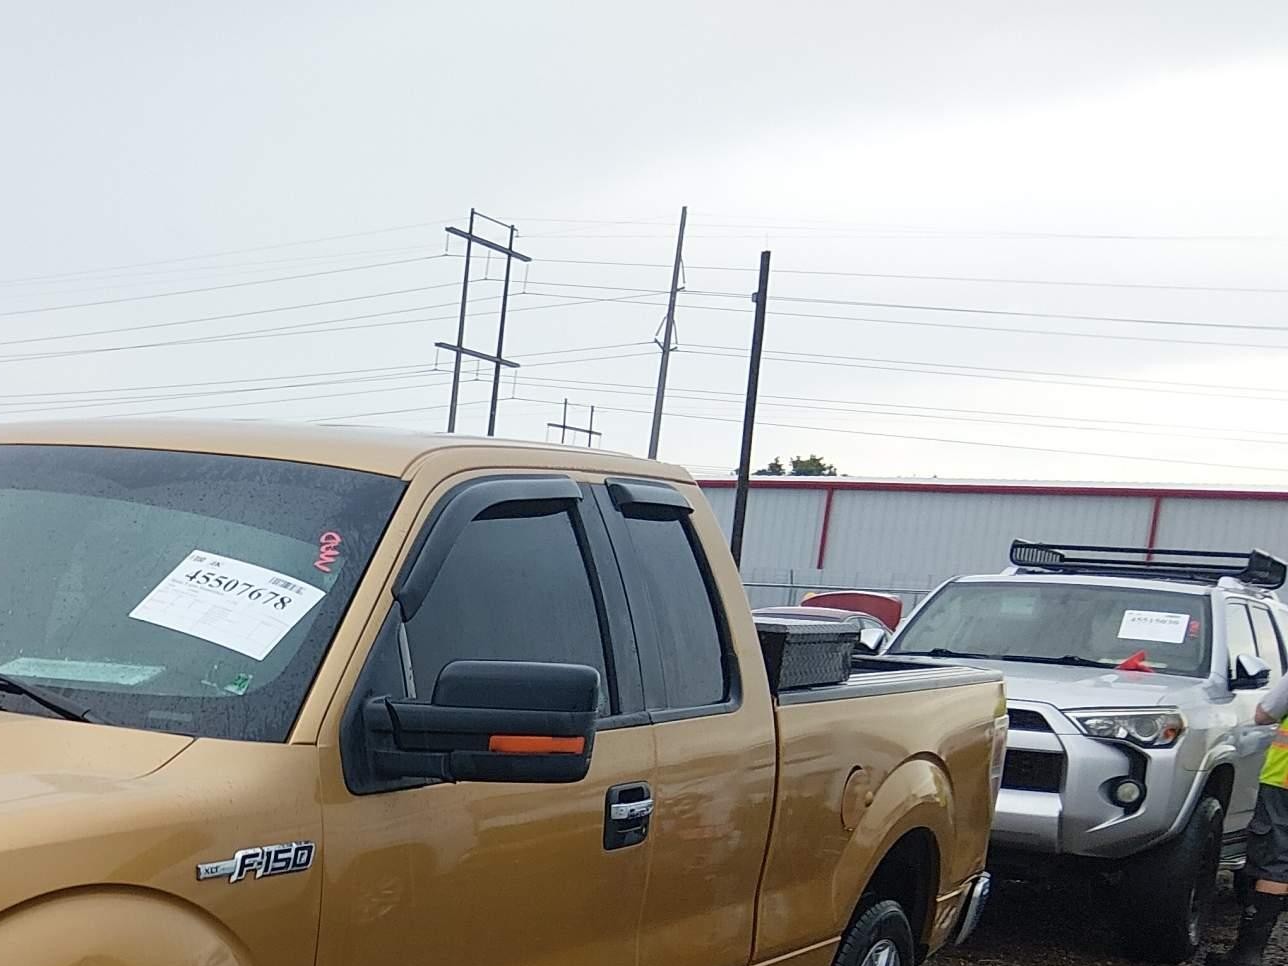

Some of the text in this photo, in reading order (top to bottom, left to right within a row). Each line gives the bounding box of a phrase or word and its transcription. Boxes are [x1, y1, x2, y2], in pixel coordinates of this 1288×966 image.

[185, 569, 293, 610] 45507678
[203, 842, 315, 883] XLT F-150
